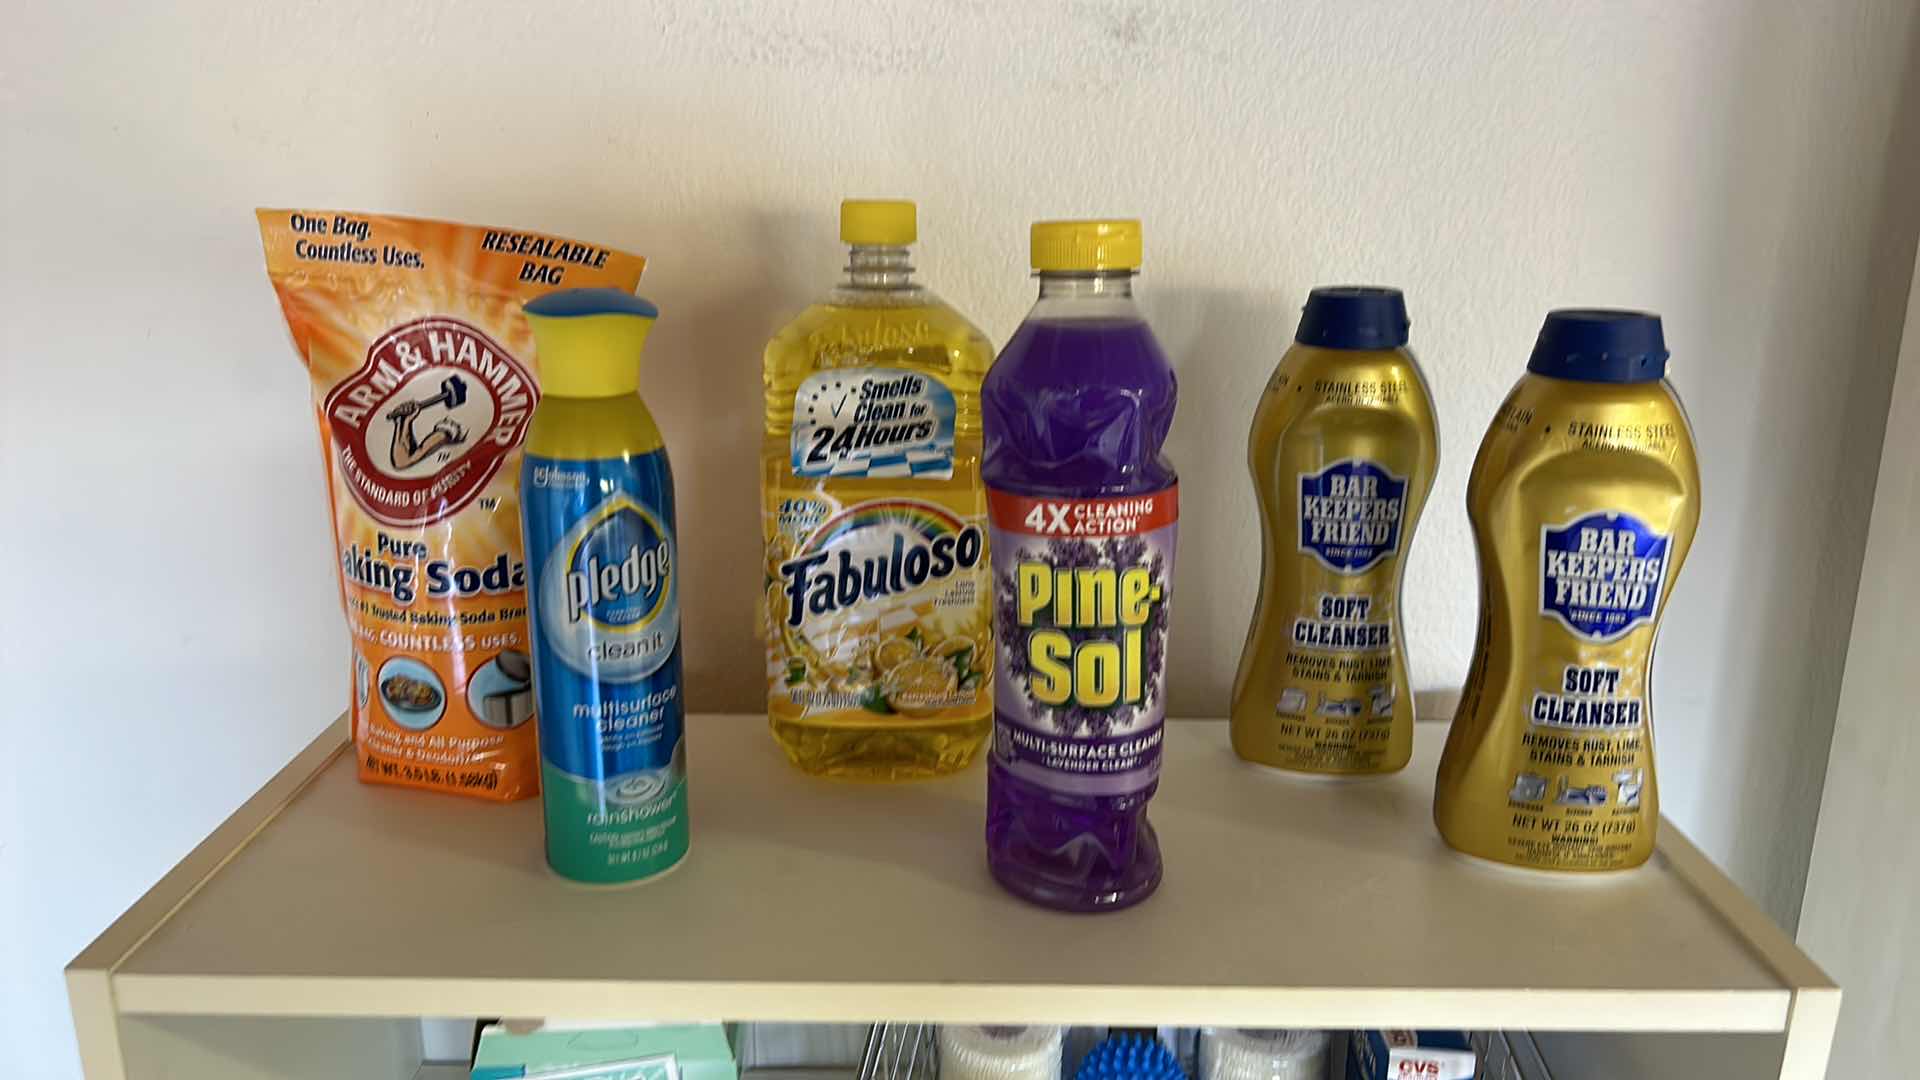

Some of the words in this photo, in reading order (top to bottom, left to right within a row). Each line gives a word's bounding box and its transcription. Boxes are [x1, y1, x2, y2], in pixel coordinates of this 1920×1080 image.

[290, 213, 327, 233] One
[331, 215, 372, 240] Bag.
[295, 239, 378, 264] Countless
[382, 245, 425, 269] Uses.
[481, 230, 610, 269] RESEALABLE
[518, 262, 565, 285] BAG
[334, 358, 401, 430] ARM
[395, 340, 427, 369] &
[428, 330, 528, 447] HAMMER
[859, 375, 927, 401] Smells
[853, 399, 907, 424] Clean
[909, 403, 928, 417] for
[806, 425, 855, 464] 24
[854, 419, 933, 450] Hours
[1568, 421, 1642, 440] STAINLESS
[353, 469, 410, 507] STANDARD
[412, 491, 429, 505] OF
[1330, 474, 1378, 497] BAR
[1025, 503, 1072, 535] 4X
[1074, 498, 1153, 520] CLEANING
[1304, 495, 1400, 521] KEEPERS
[377, 531, 428, 559] Pure
[1311, 519, 1391, 545] FRIEND
[1579, 527, 1637, 556] BAR
[343, 543, 415, 603] aking
[781, 527, 982, 627] Fabuloso
[1547, 550, 1661, 584] KEEPERS
[566, 537, 672, 624] pledge
[1017, 562, 1161, 627] Pine-
[1321, 596, 1370, 619] SOFT
[1554, 578, 1648, 611] FRIEND
[460, 611, 496, 625] Soda
[1570, 609, 1602, 623] SINCE
[380, 629, 476, 651] COUNTLESS
[588, 638, 650, 662] clean
[651, 630, 665, 651] it
[1294, 621, 1390, 647] CLEANSER
[1029, 627, 1142, 708] Sol
[1286, 652, 1336, 668] REMOVES
[1292, 667, 1330, 681] STAINS
[1565, 667, 1620, 693] SOFT
[573, 685, 677, 719] multisurface
[1533, 695, 1641, 725] CLEANSER
[595, 706, 665, 732] cleaner
[1013, 728, 1117, 760] MULTI-SURFACE
[1522, 733, 1580, 752] REMOVES
[1529, 750, 1574, 766] STAINS
[1590, 754, 1635, 768] TARNISH
[1512, 813, 1537, 831] NET
[1541, 818, 1560, 832] WT
[1564, 821, 1580, 833] 26
[1583, 820, 1601, 833] OZ
[1398, 1060, 1440, 1074] CVS
